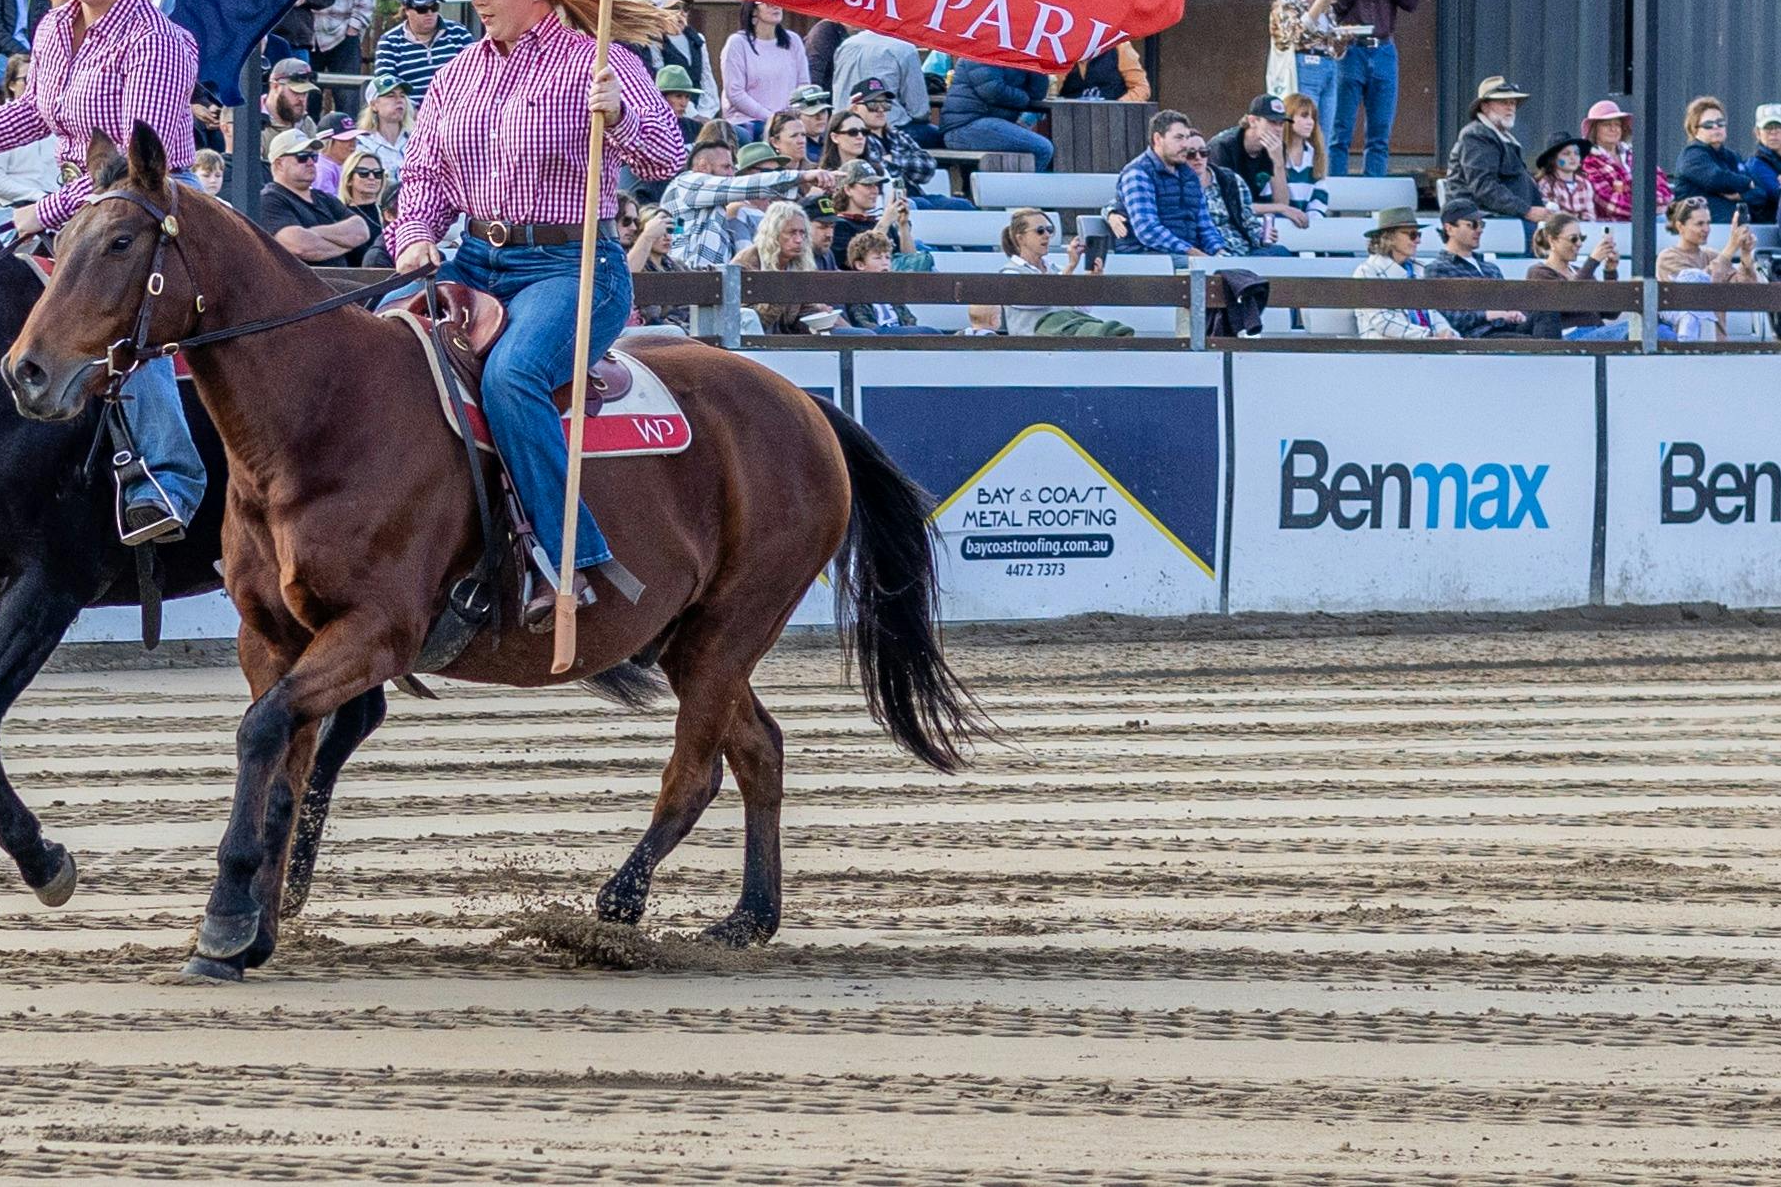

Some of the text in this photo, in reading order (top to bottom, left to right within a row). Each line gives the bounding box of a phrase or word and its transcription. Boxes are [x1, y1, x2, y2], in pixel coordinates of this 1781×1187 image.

[1279, 439, 1550, 531] Benmax
[1660, 442, 1781, 524] Ben
[977, 486, 1107, 504] BAY & COAST
[962, 508, 1117, 528] METAL ROOFING
[966, 538, 1108, 556] baycoastroofing.com.au
[1006, 562, 1066, 576] 4472 7373
